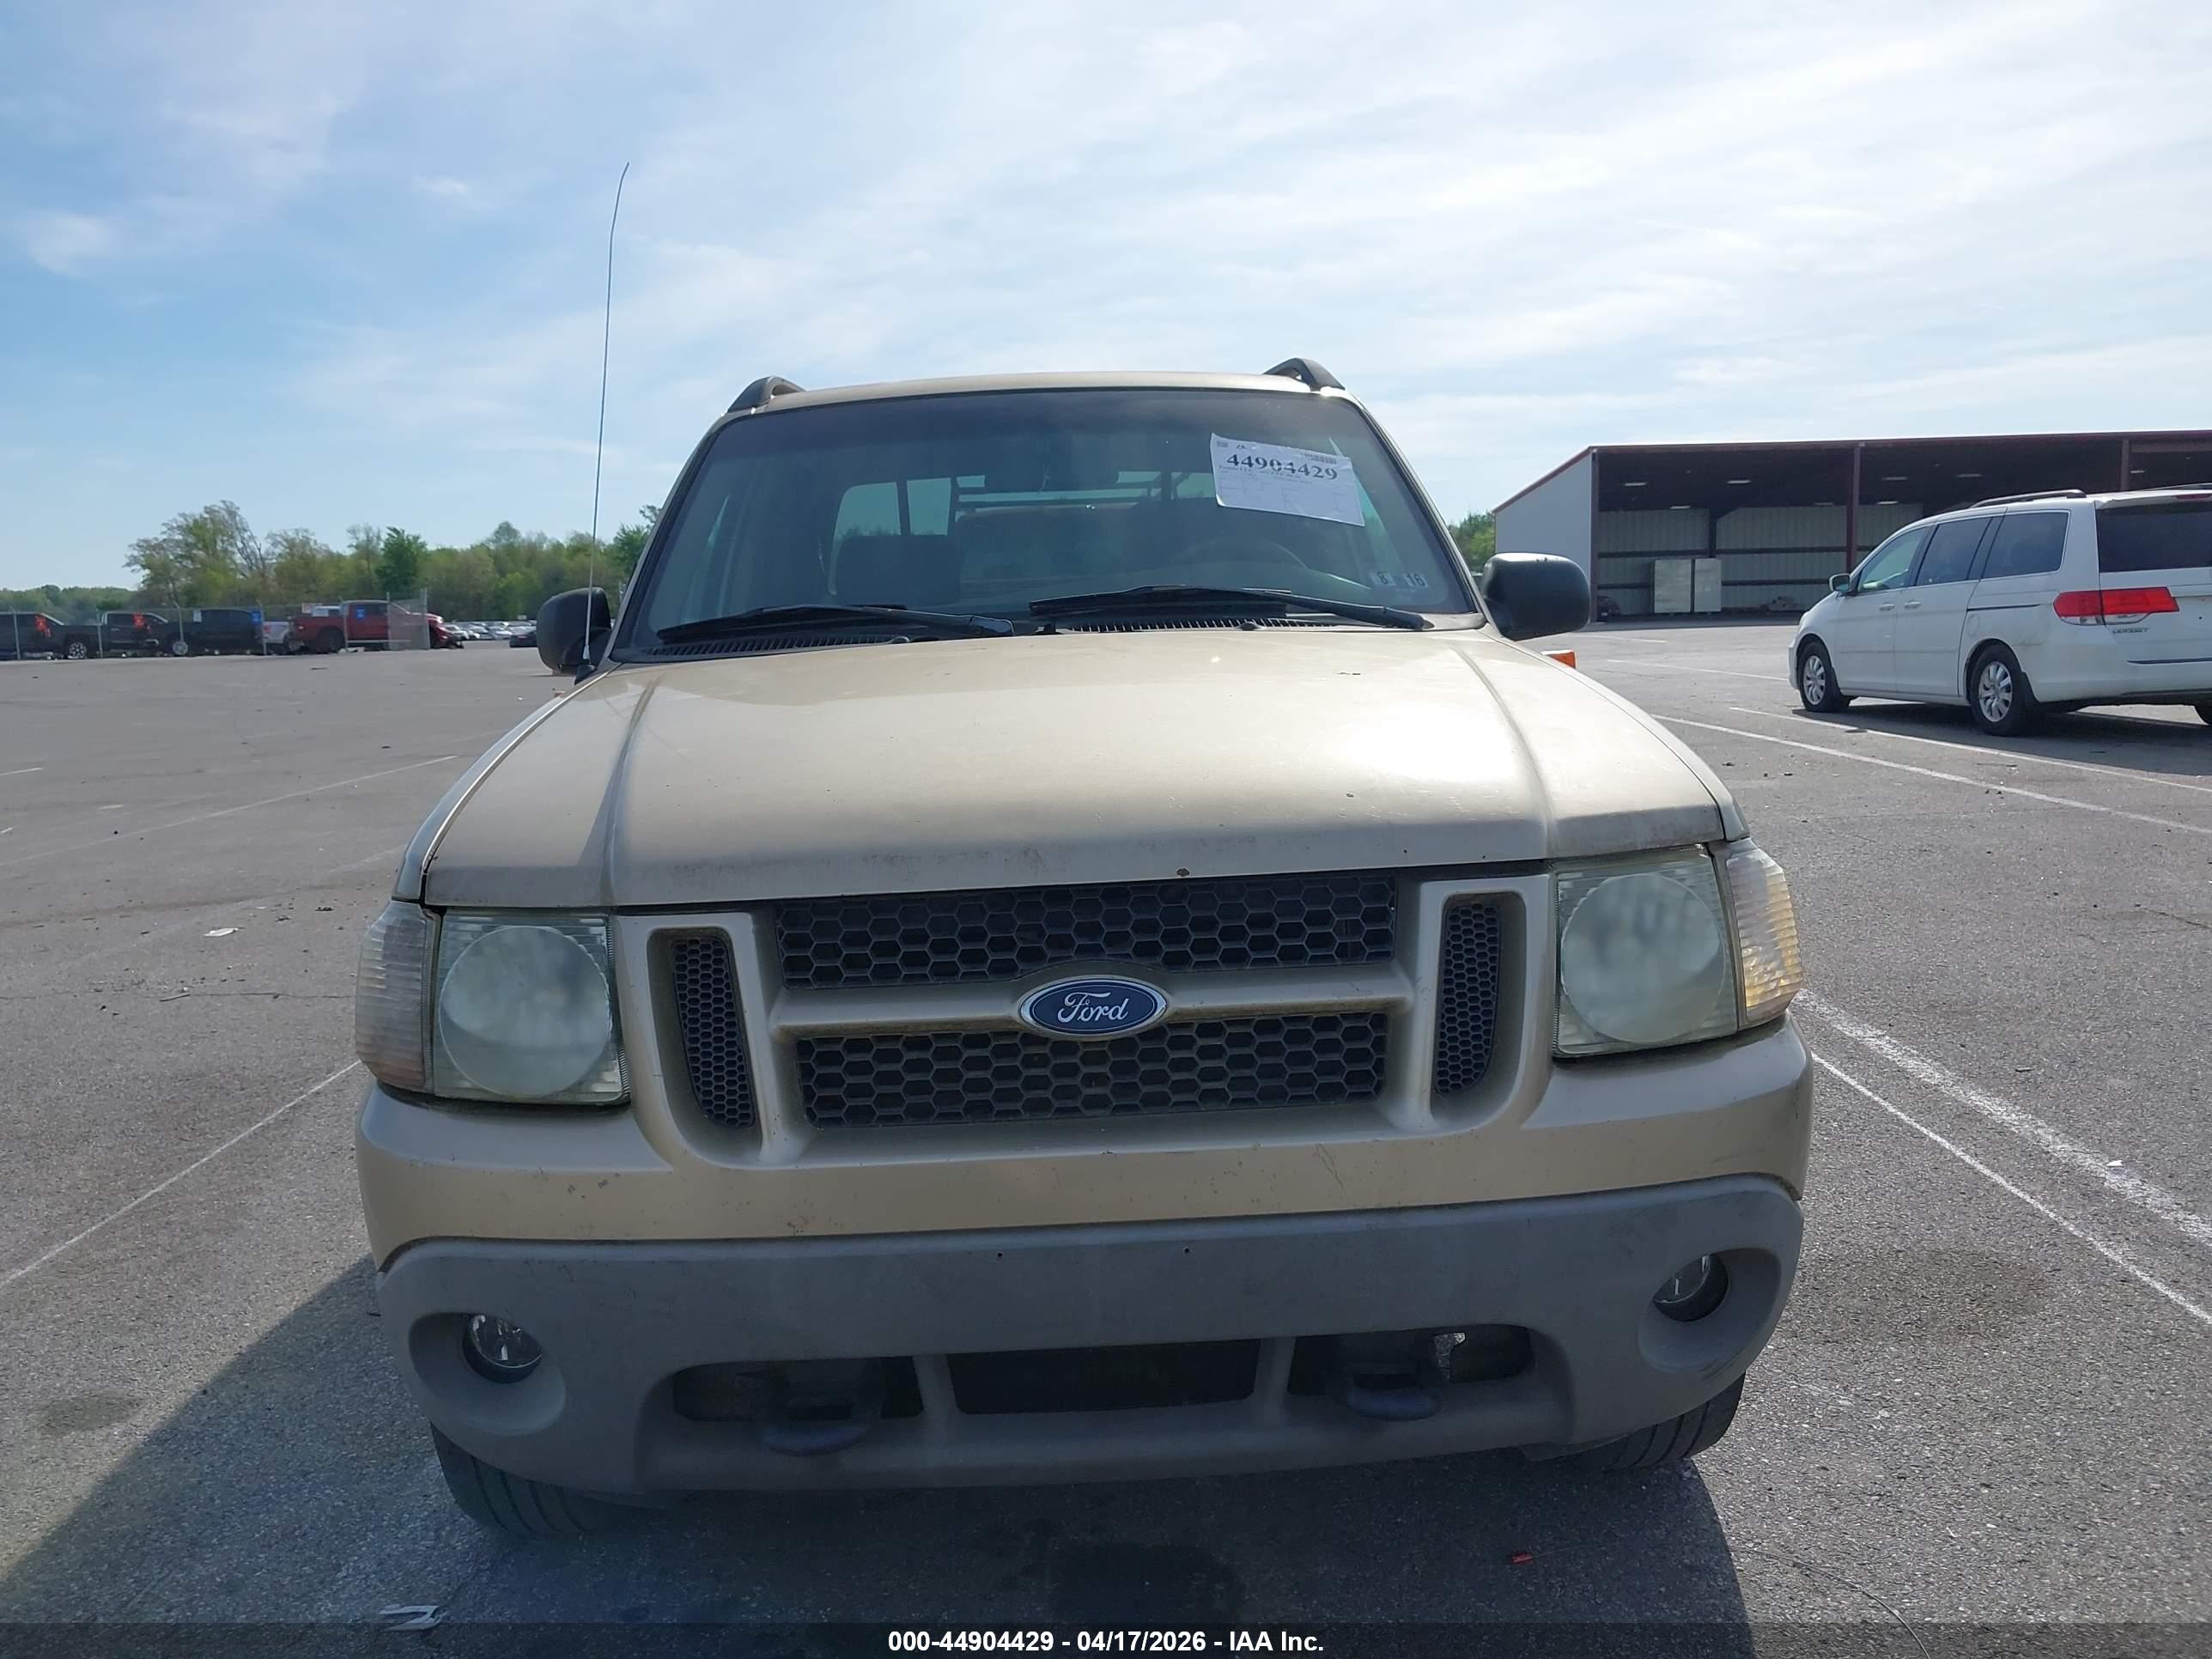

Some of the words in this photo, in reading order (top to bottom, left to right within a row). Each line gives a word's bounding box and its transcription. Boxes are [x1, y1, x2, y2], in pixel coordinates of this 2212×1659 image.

[1226, 453, 1338, 480] 44904429
[1406, 573, 1425, 586] 16
[1057, 991, 1130, 1023] Ford
